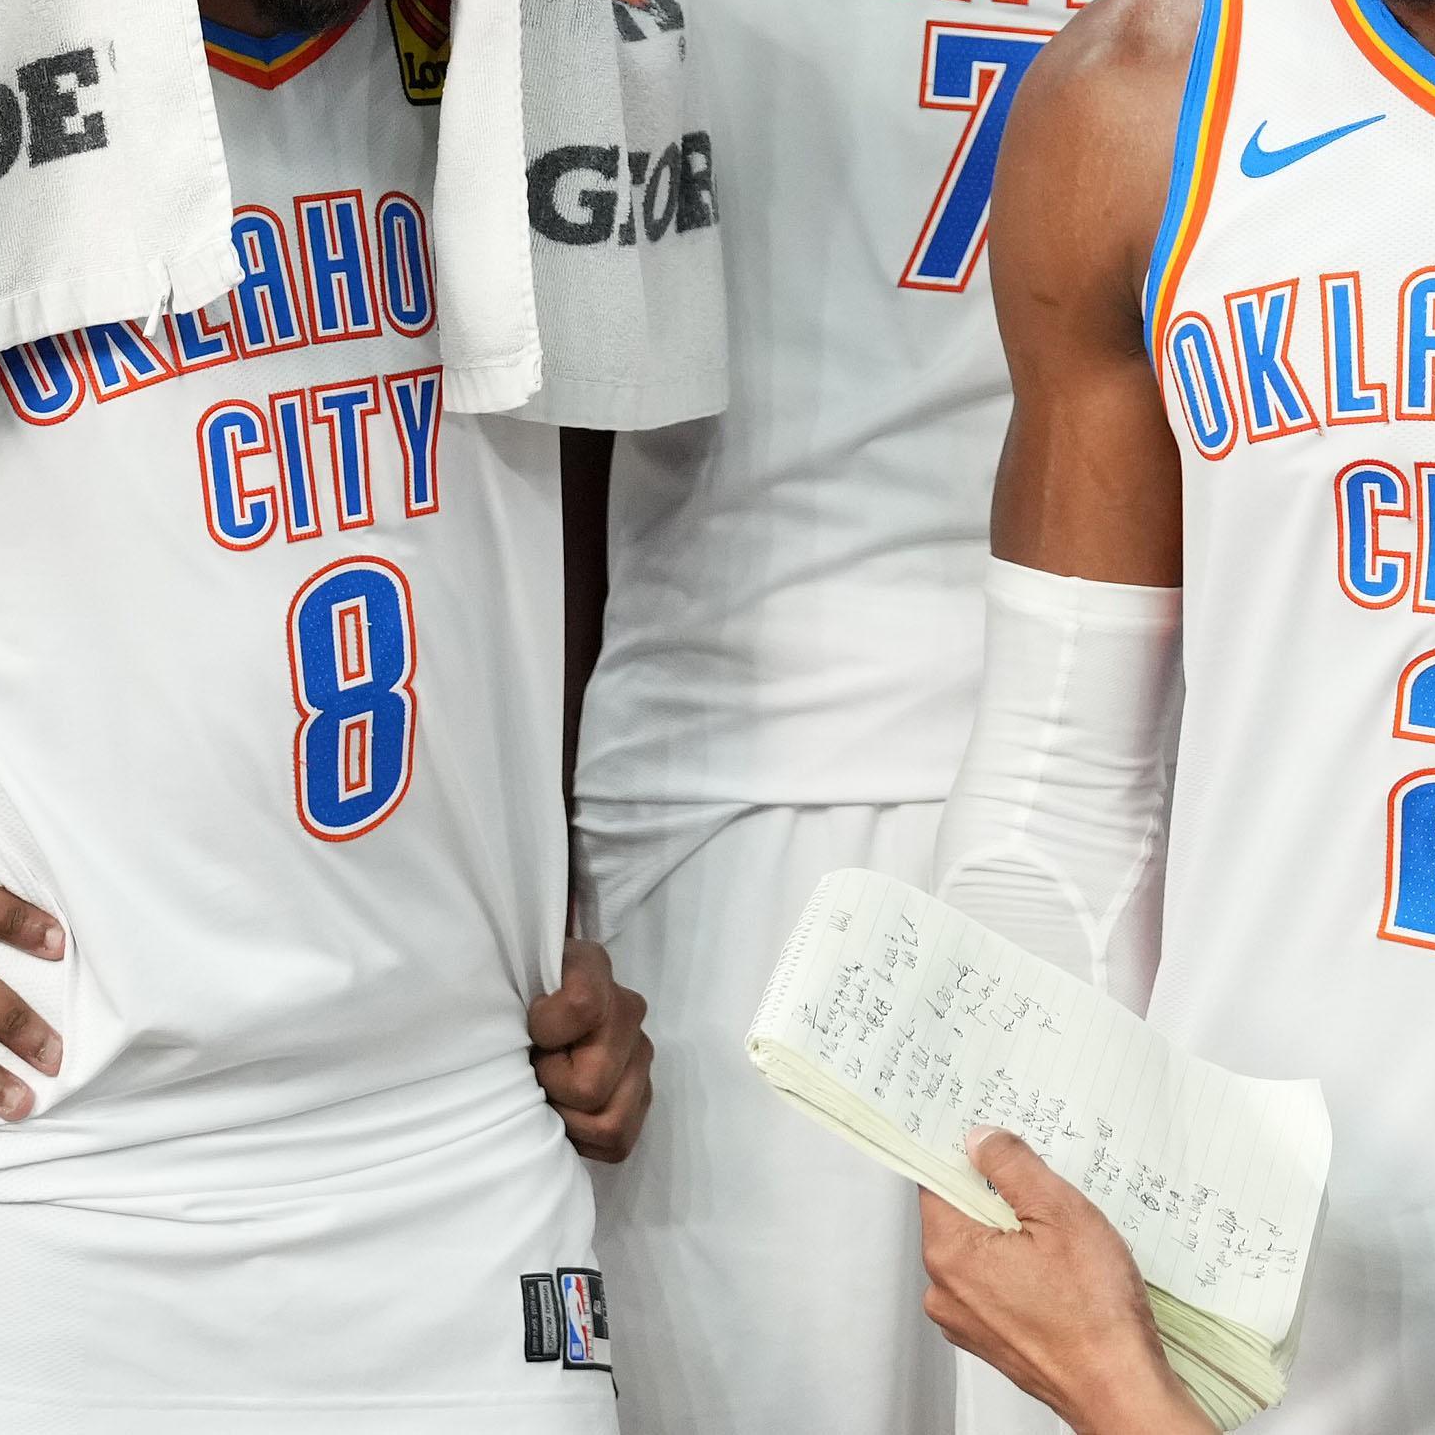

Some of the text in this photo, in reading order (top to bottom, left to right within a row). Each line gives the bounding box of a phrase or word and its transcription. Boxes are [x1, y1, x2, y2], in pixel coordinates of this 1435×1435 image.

[898, 21, 1065, 292] 7
[197, 365, 444, 551] CITY
[285, 556, 417, 842] 8
